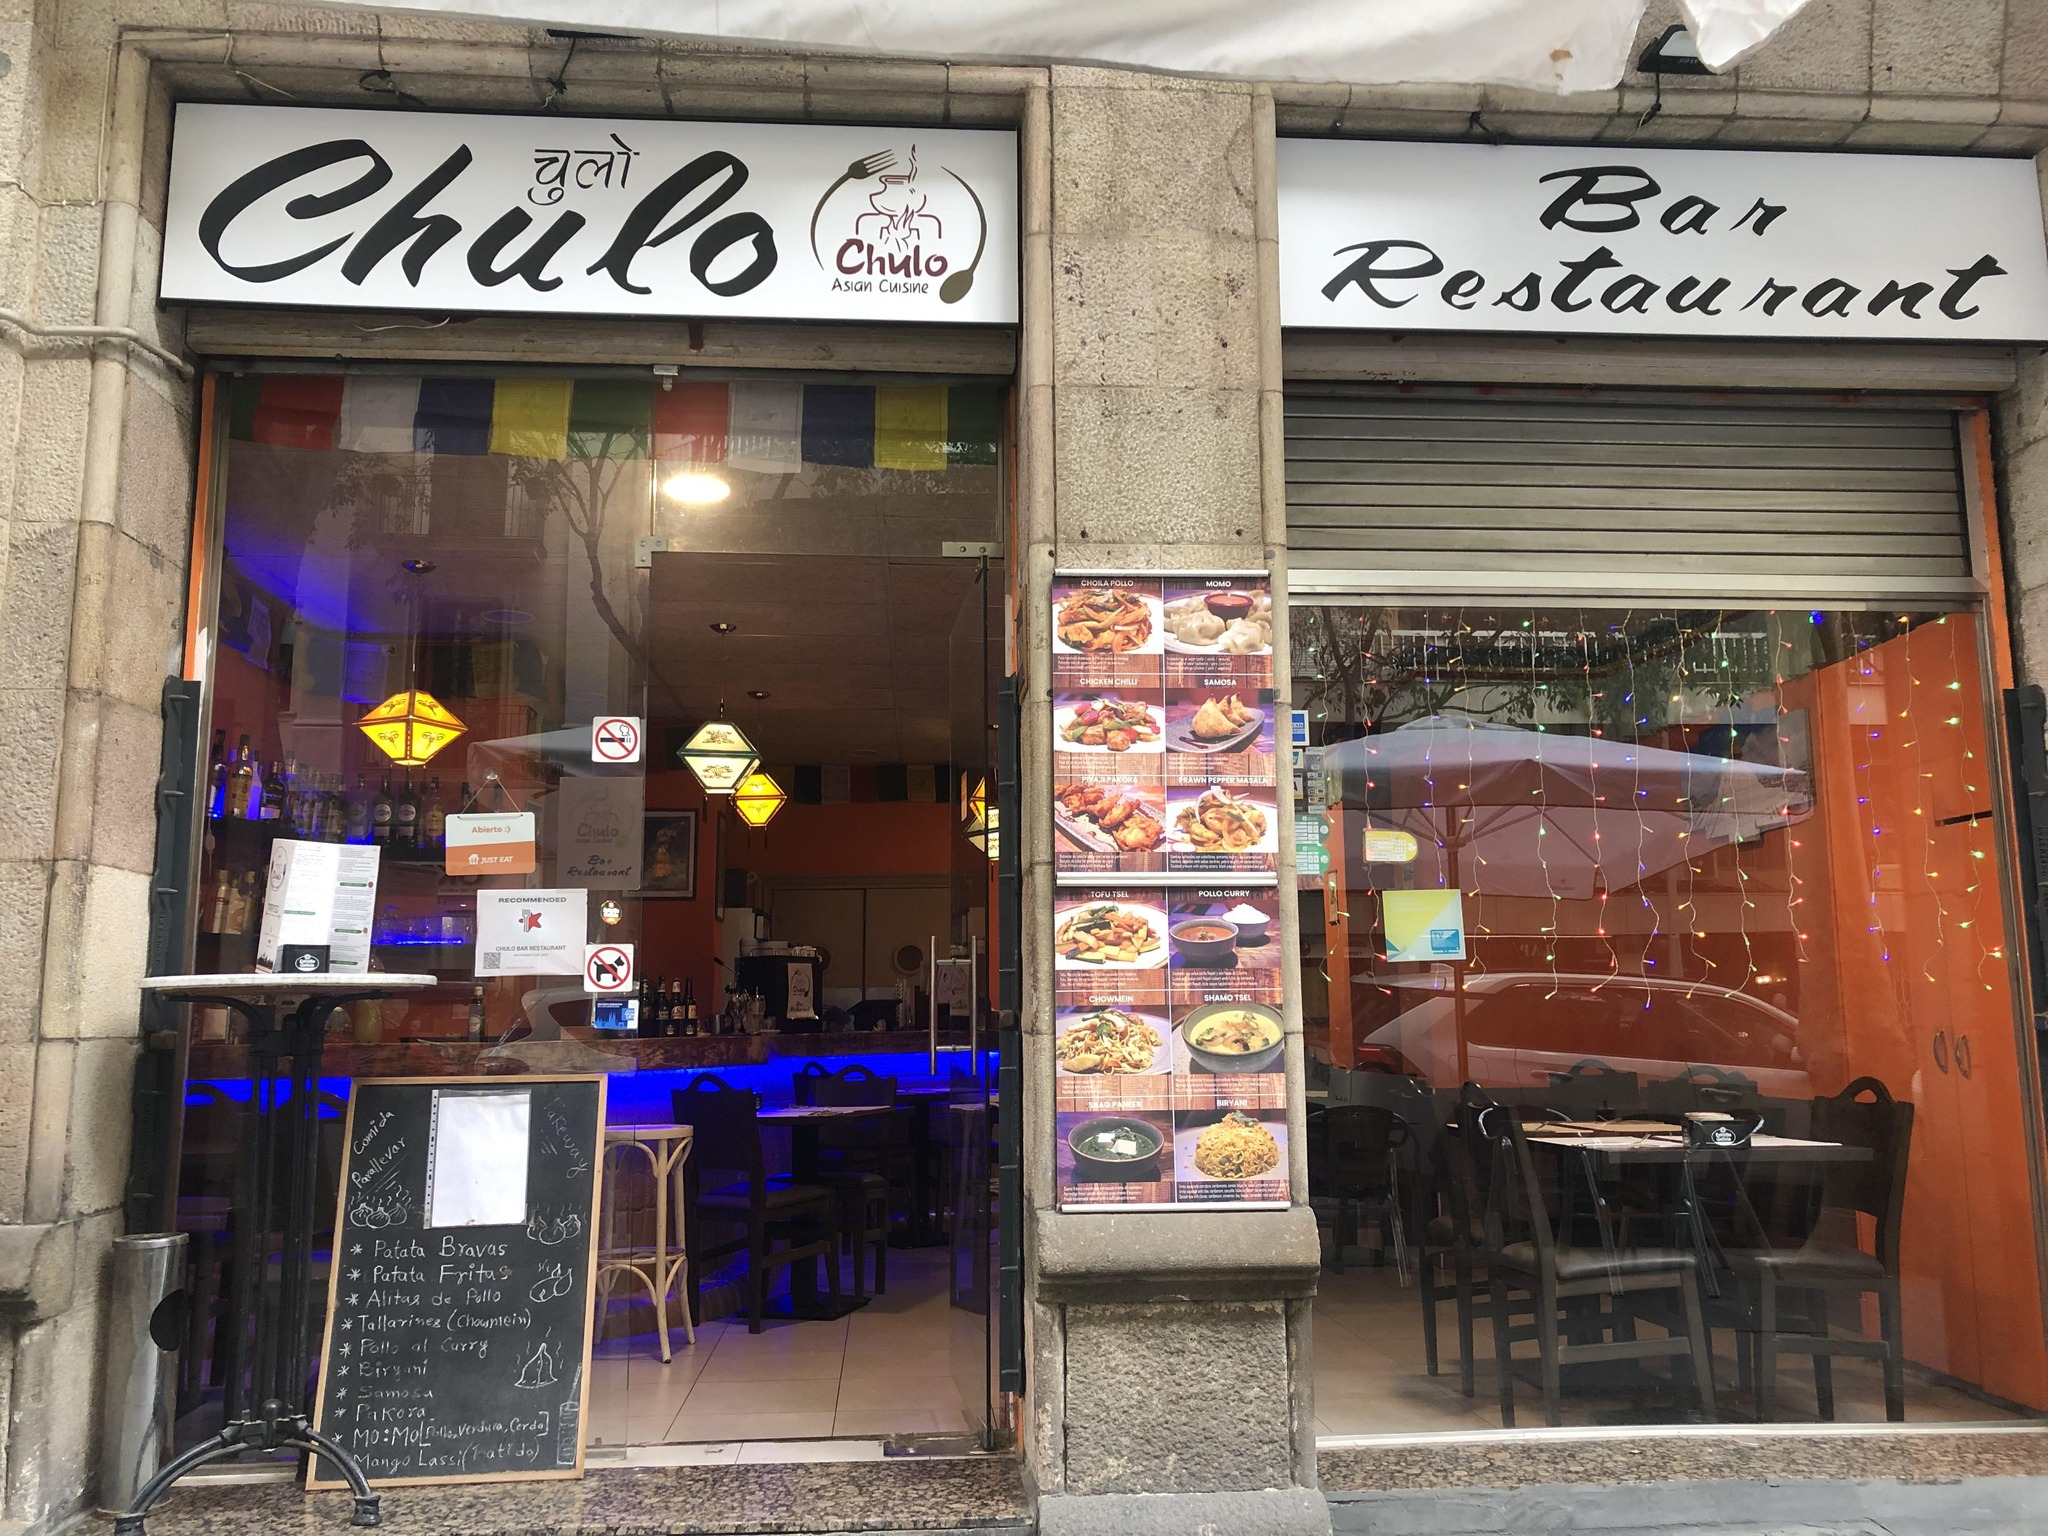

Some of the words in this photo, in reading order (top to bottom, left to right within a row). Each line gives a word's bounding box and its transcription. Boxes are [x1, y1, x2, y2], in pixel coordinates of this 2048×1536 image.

[527, 133, 640, 206] चुलो
[1538, 164, 1787, 236] Bar
[198, 138, 778, 297] Chulo
[836, 238, 948, 278] Chulo
[831, 277, 872, 292] Asian
[878, 279, 929, 294] Cuisine
[1321, 239, 2009, 320] Restaurant
[1081, 579, 1109, 587] CHOILA
[1079, 677, 1114, 685] CHICKEN
[1204, 678, 1237, 686] SAMOSA
[1106, 776, 1138, 784] PAKORA
[1179, 776, 1207, 784] PRAWN
[1208, 776, 1236, 784] PEPPER
[1236, 776, 1268, 785] MASALA
[471, 825, 503, 834] Abierto
[576, 822, 620, 838] Chulo
[480, 857, 499, 865] JUST
[499, 855, 514, 863] EAT
[587, 854, 612, 865] Bar
[566, 866, 633, 877] Restaurant
[1090, 890, 1111, 898] TOFU
[1089, 995, 1134, 1003] CHOWMEIN
[1204, 994, 1234, 1002] SHAMO
[1111, 1101, 1143, 1109] PANEER
[1216, 1099, 1248, 1107] BIRYANI
[353, 1111, 395, 1155] Comida
[374, 1239, 426, 1260] Patata
[438, 1235, 508, 1258] Bravas
[373, 1265, 425, 1284] Patata
[439, 1263, 509, 1285] Fritas
[365, 1289, 420, 1308] Alitas
[431, 1291, 452, 1306] de
[465, 1287, 501, 1306] Pollo
[357, 1314, 441, 1333] Tallarines
[360, 1338, 400, 1357] Pollo
[411, 1338, 428, 1353] al
[440, 1336, 489, 1359] Curry
[358, 1358, 429, 1382] Biryani
[357, 1385, 434, 1399] Samosa
[353, 1454, 411, 1475] Mango
